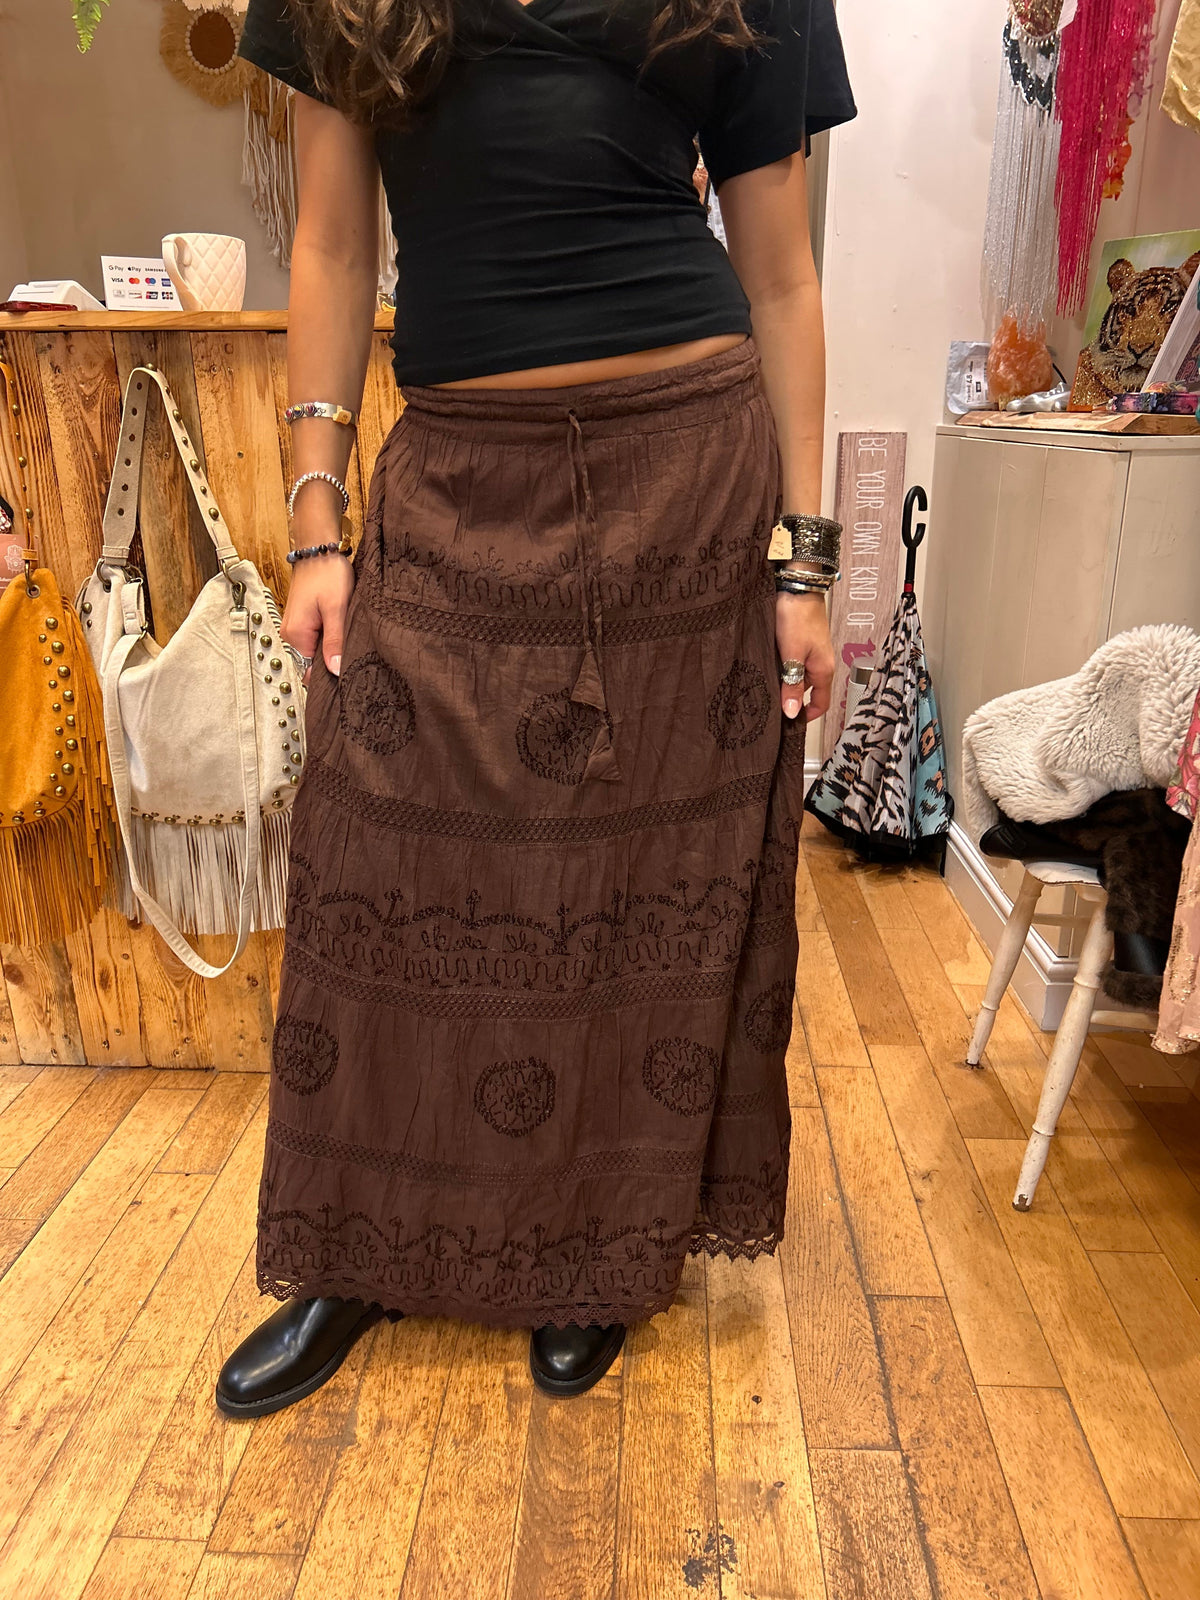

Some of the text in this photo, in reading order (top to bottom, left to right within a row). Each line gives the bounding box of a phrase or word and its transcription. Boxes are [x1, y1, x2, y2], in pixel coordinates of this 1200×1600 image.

[858, 437, 887, 456] BE
[855, 470, 887, 510] YOUR
[852, 522, 882, 554] OWN
[849, 566, 880, 601] KIND
[846, 612, 876, 631] OF
